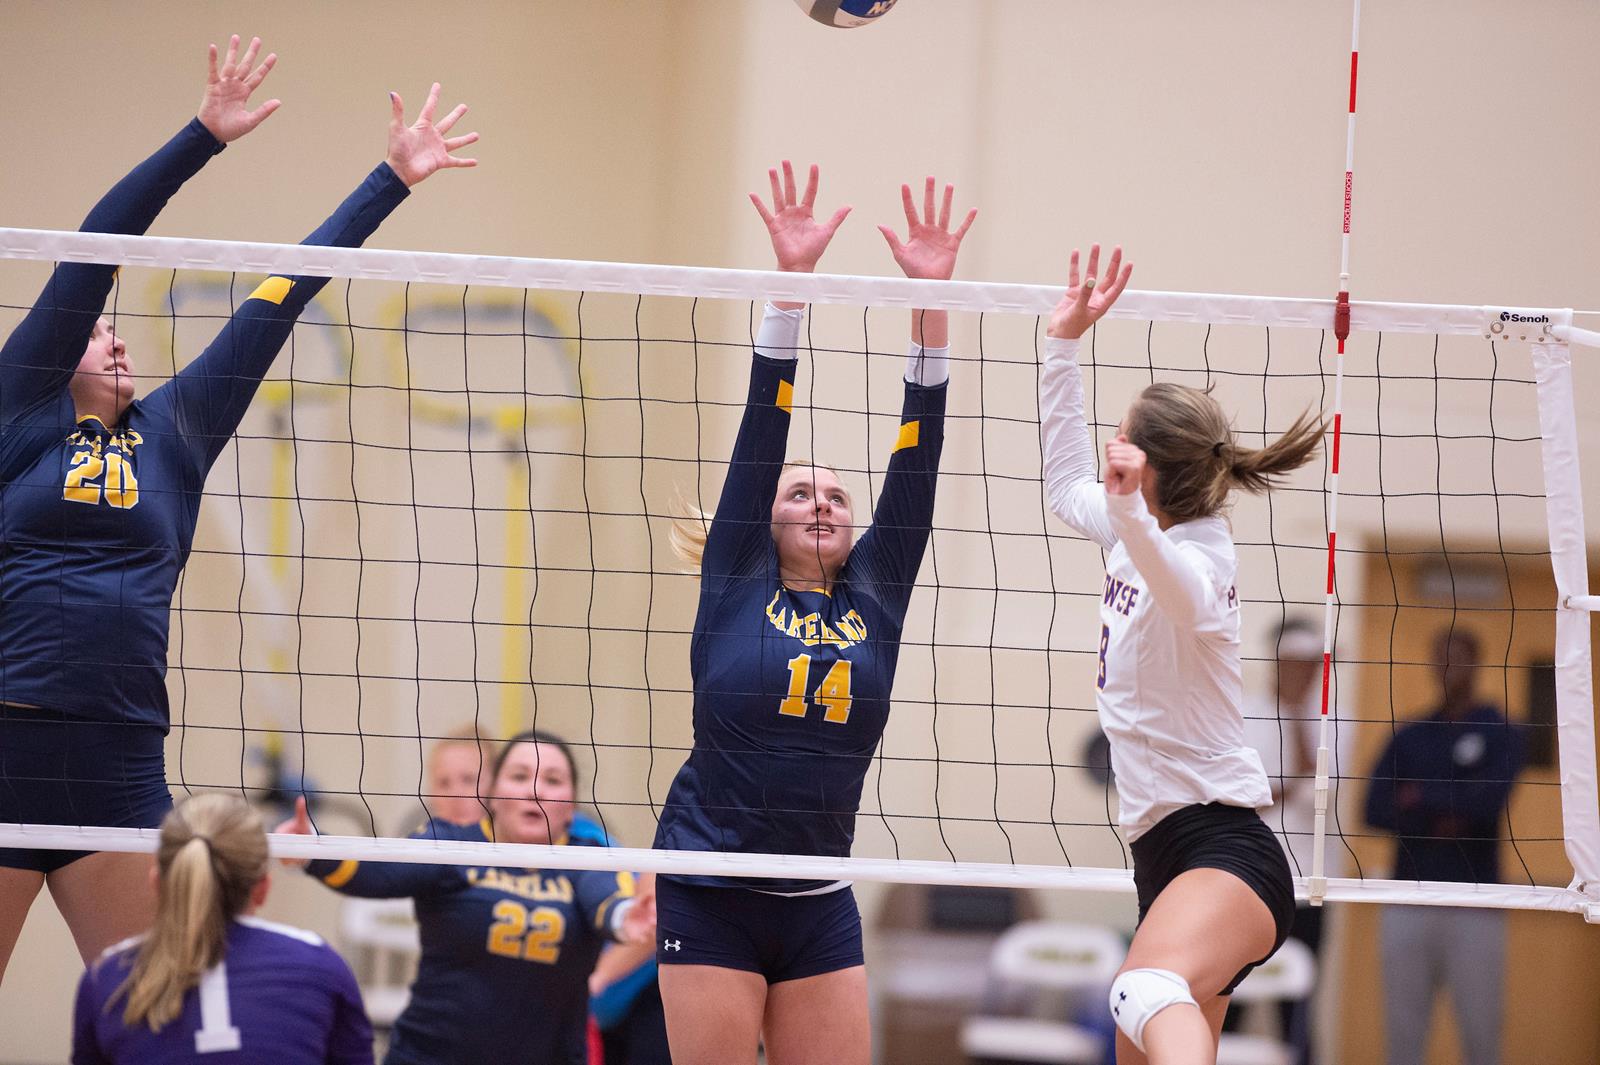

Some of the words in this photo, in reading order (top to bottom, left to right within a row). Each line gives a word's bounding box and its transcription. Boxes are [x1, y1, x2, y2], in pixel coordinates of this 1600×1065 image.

[1511, 313, 1549, 323] Senoh
[63, 451, 139, 510] 20
[766, 589, 868, 650] LAKELAND
[778, 653, 853, 724] 14
[486, 899, 566, 965] 22
[194, 960, 242, 1054] 1
